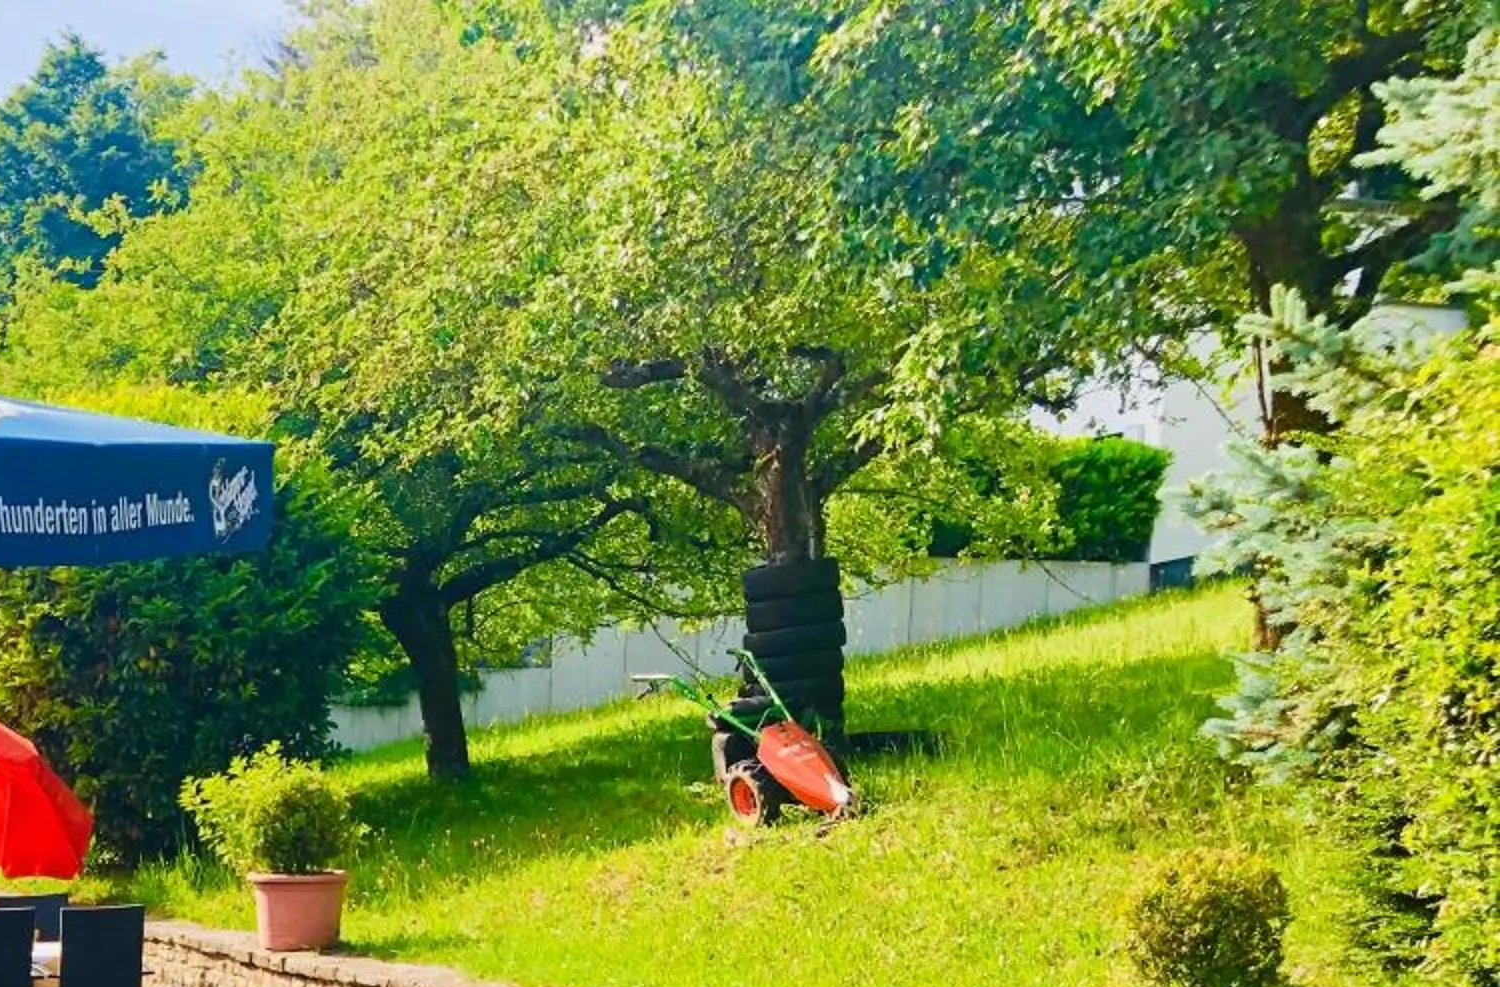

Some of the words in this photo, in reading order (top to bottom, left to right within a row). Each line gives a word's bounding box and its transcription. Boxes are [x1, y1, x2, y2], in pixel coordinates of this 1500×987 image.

[91, 499, 108, 535] in
[110, 496, 143, 532] aller
[145, 490, 196, 528] Munde.
